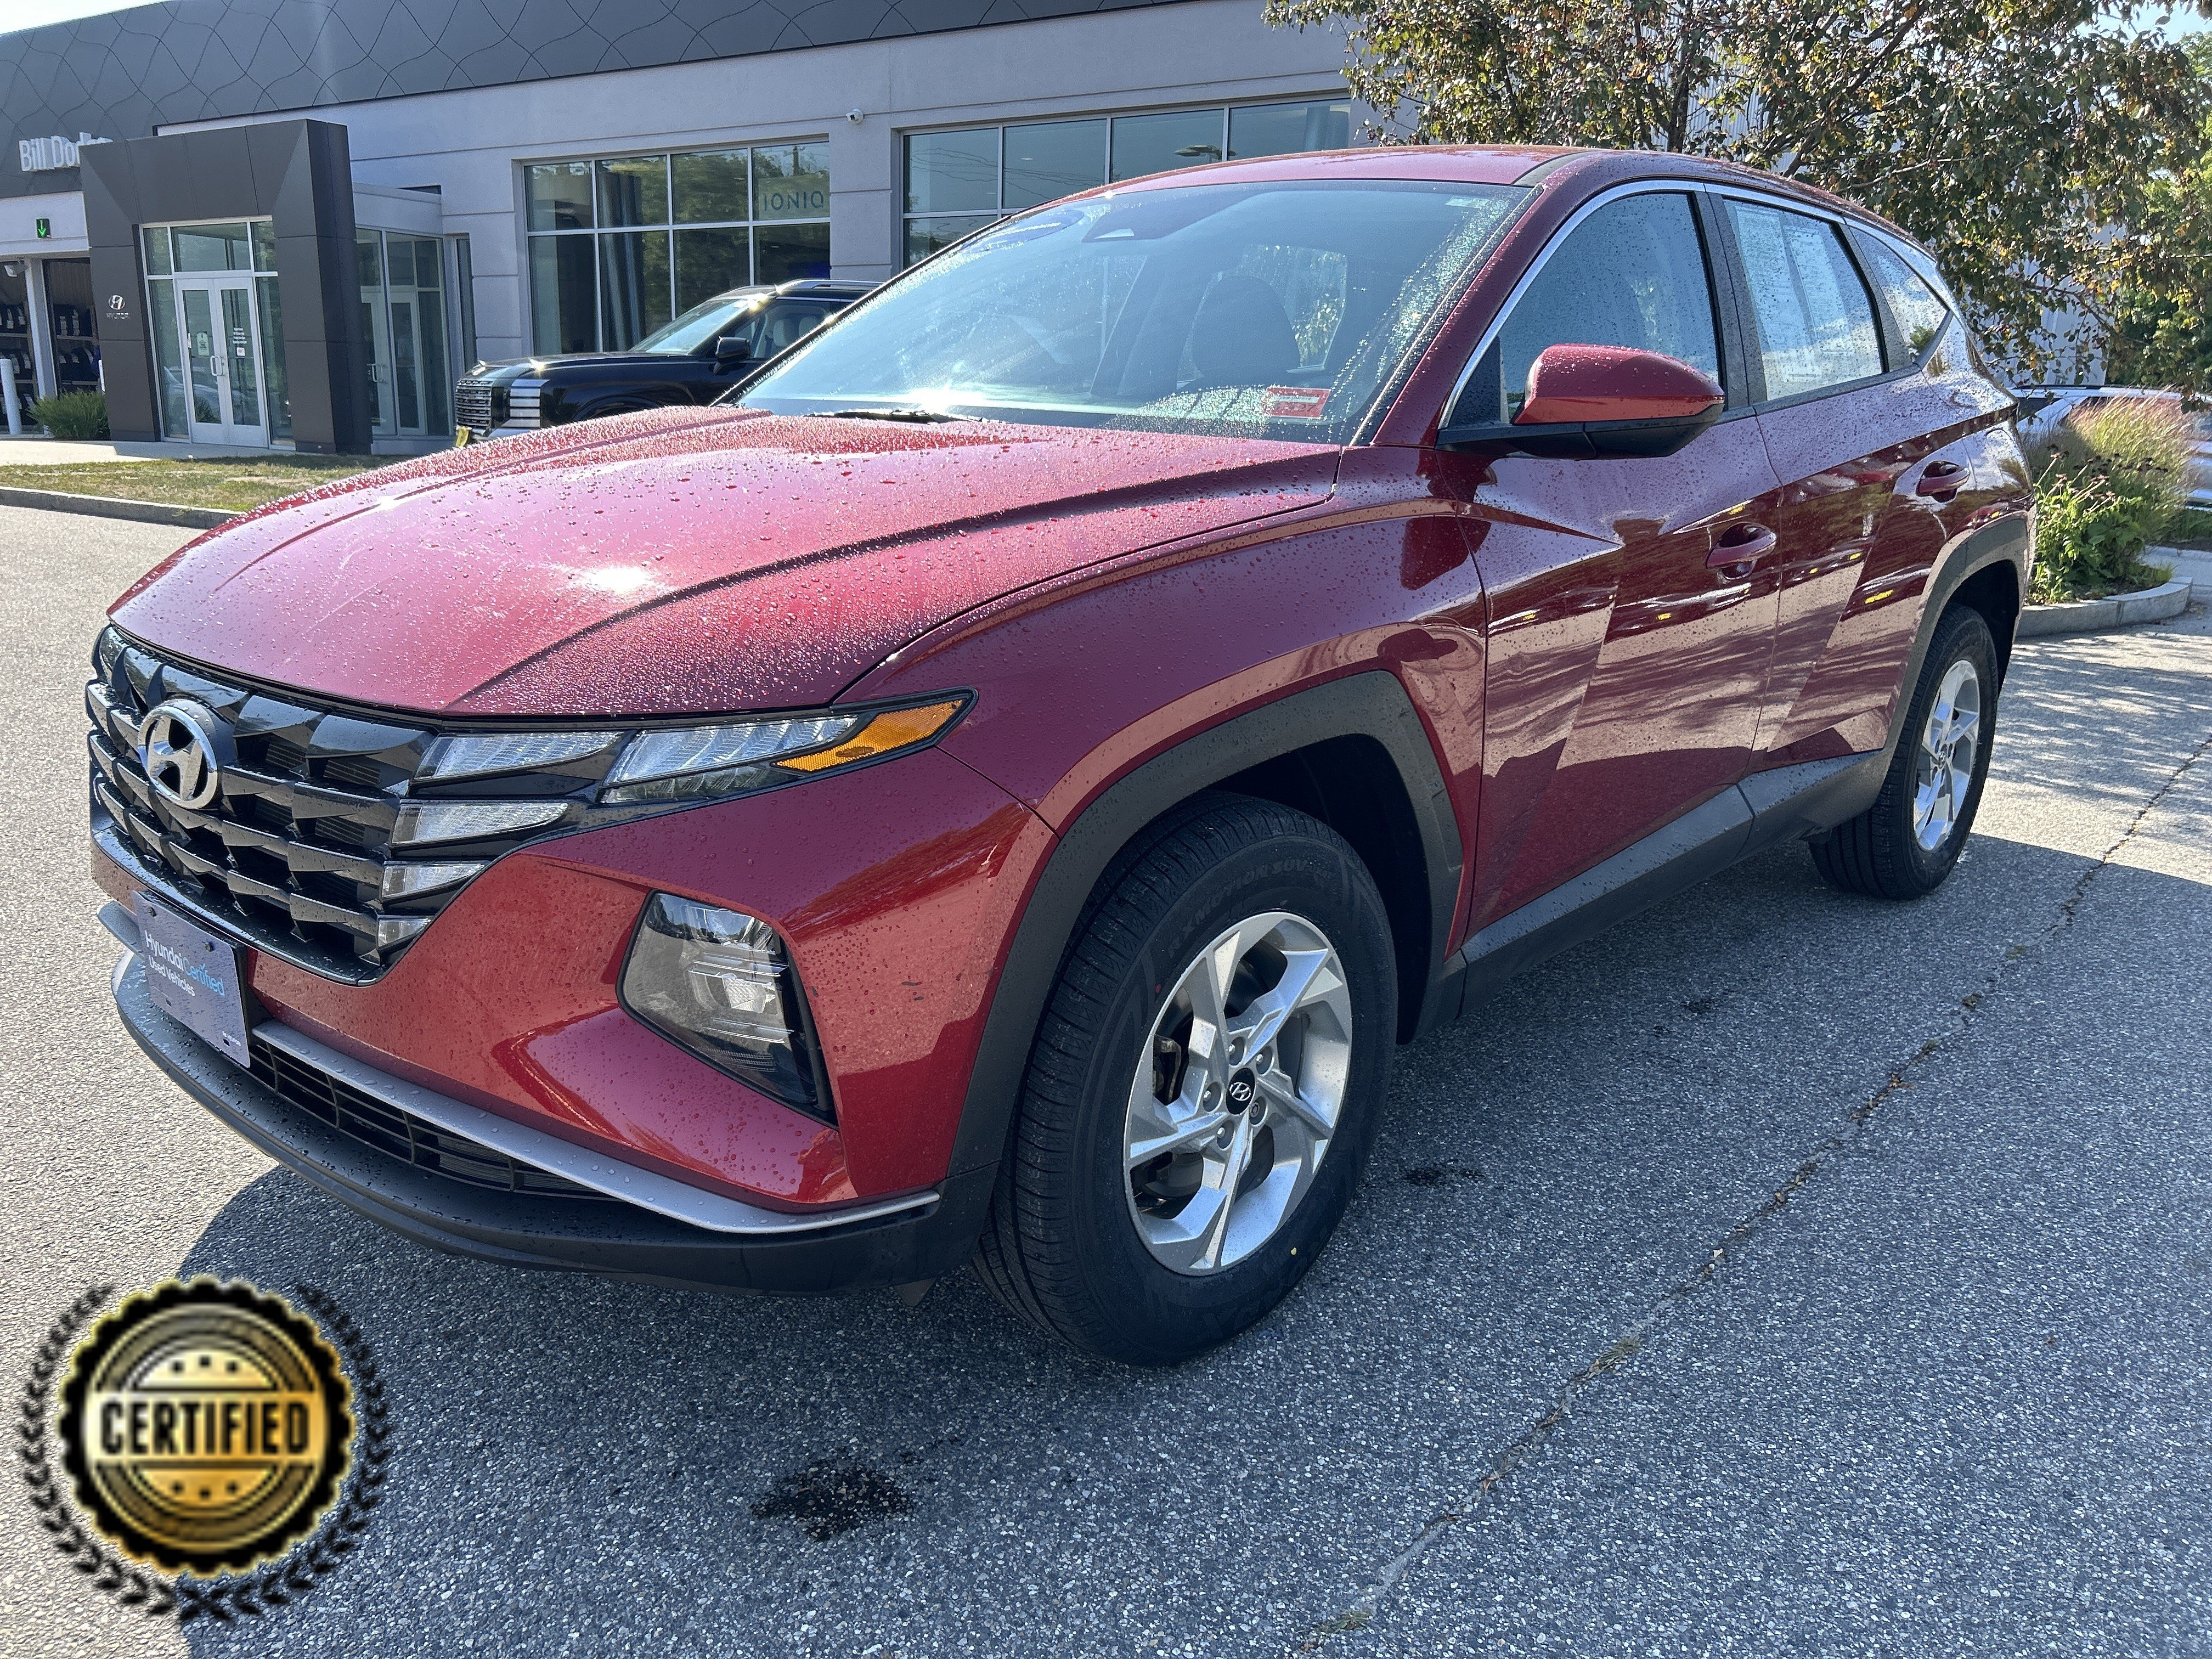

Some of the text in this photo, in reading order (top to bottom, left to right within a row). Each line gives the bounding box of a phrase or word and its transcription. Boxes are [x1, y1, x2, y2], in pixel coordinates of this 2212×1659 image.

[19, 137, 46, 172] Bill
[764, 190, 823, 211] IONIQ
[149, 955, 195, 997] Used Vehicles
